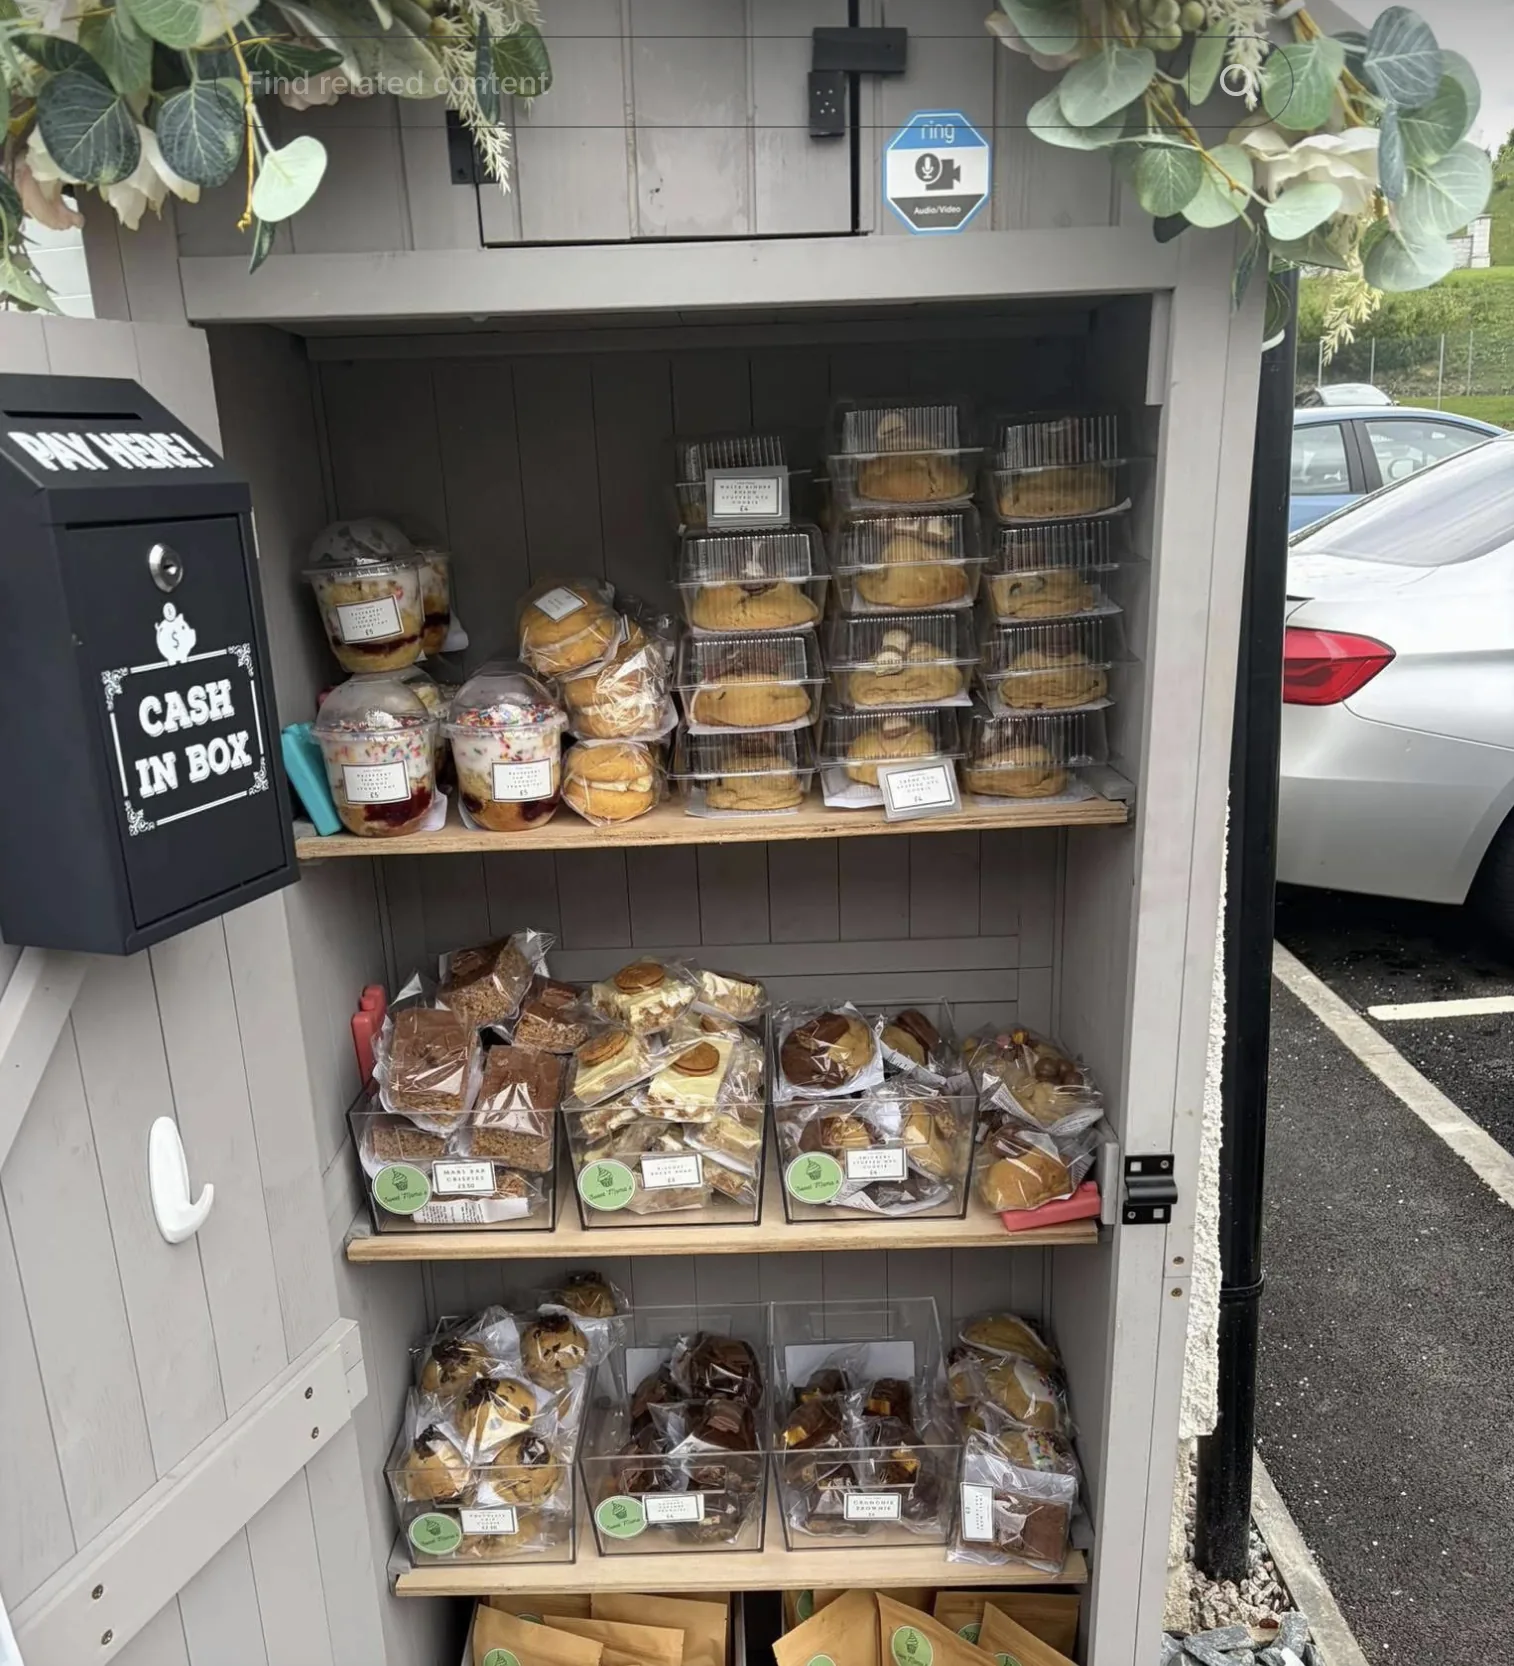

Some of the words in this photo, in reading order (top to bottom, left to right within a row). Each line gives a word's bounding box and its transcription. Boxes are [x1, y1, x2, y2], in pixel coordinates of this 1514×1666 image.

[920, 120, 955, 144] ring
[913, 206, 962, 216] Audio/Video
[8, 432, 110, 471] PAY
[85, 432, 214, 470] HERE!
[139, 678, 235, 737] CASH
[135, 751, 179, 799] IN
[185, 730, 253, 783] BOX
